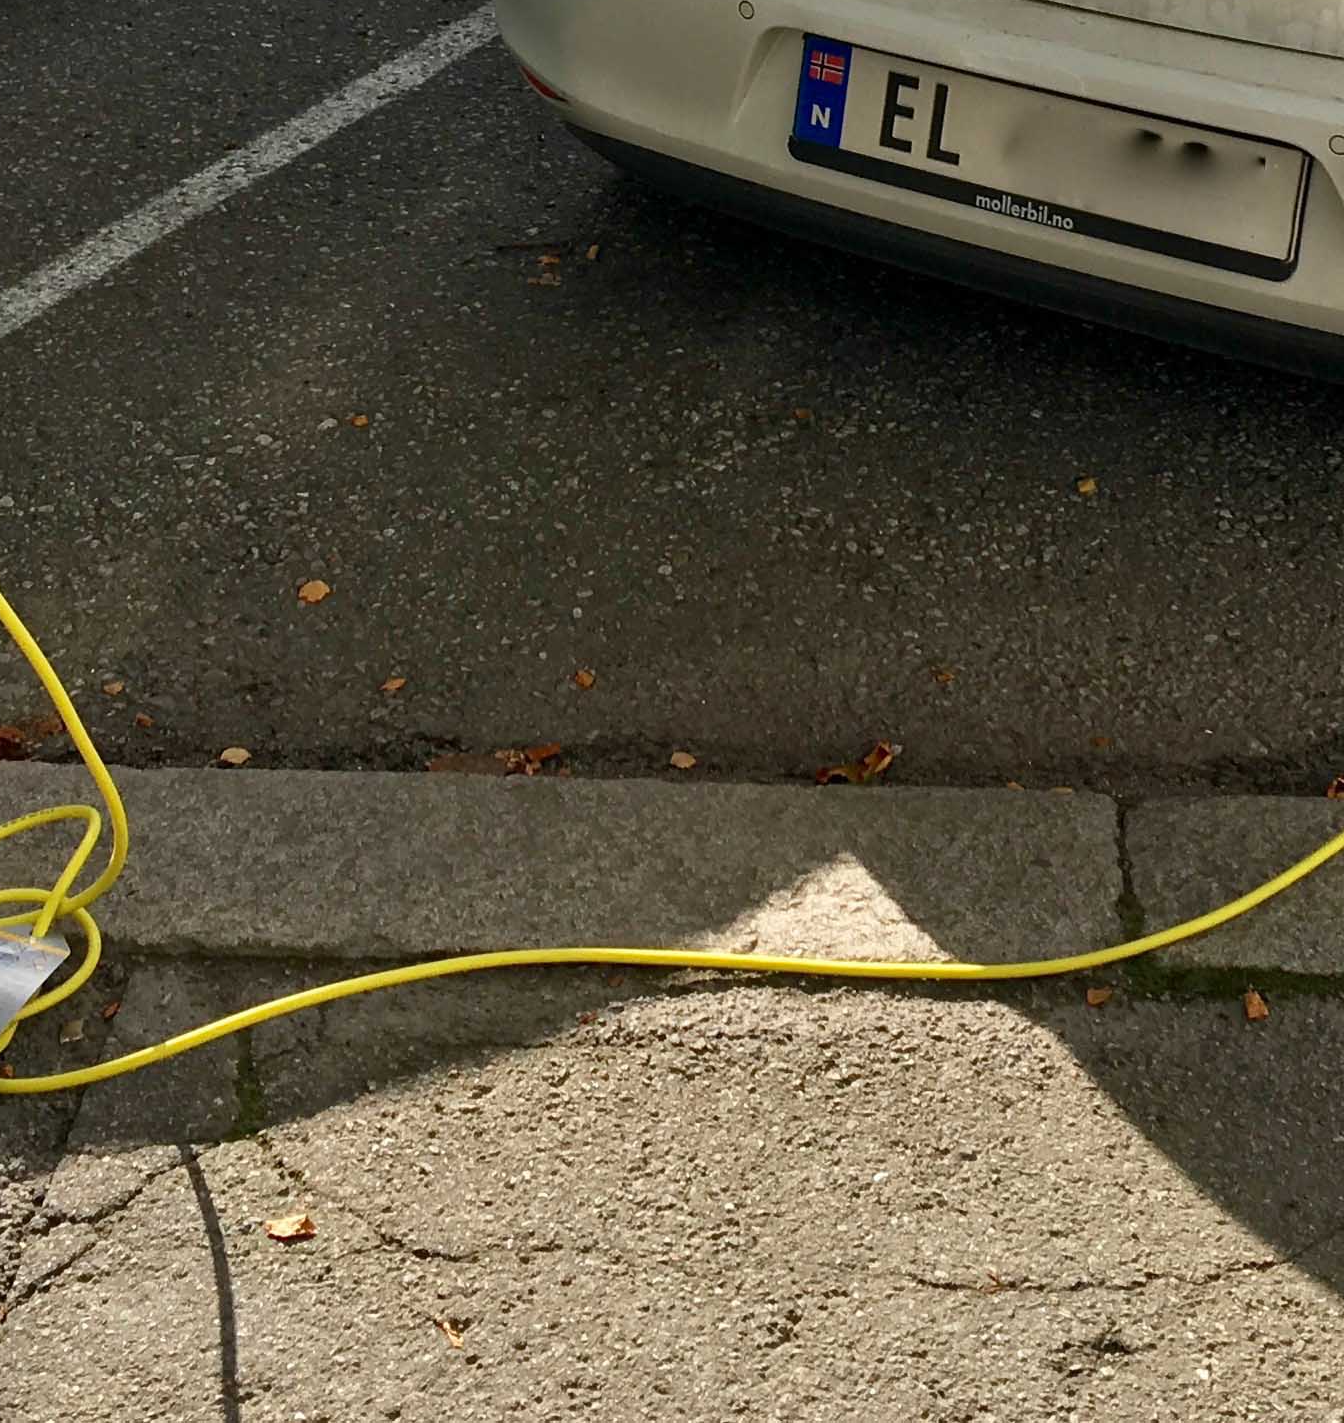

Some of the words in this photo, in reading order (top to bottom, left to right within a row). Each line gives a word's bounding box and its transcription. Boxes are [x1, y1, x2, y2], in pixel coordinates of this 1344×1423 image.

[810, 103, 831, 129] N
[879, 71, 960, 167] EL
[975, 193, 1074, 230] mollerbil.no
